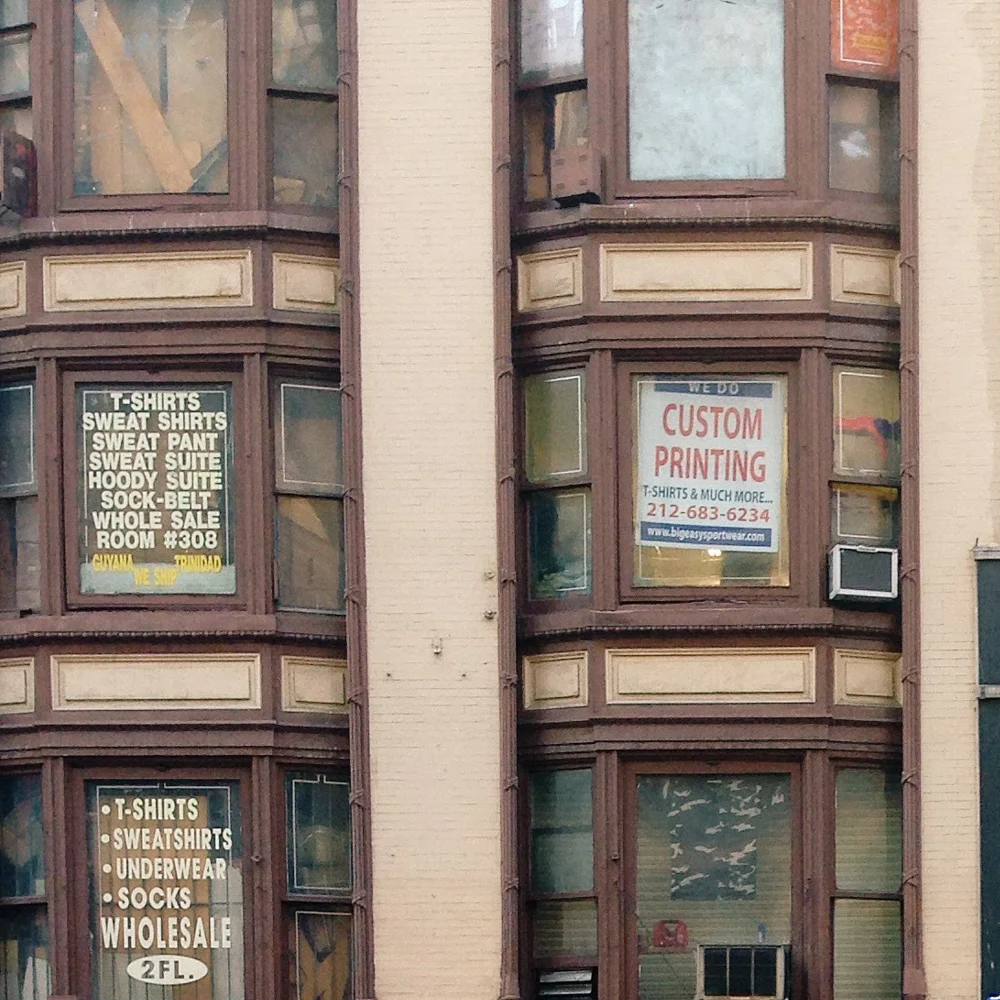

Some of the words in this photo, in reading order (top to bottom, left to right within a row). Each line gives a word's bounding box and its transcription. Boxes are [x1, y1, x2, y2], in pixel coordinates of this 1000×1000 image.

[689, 383, 710, 393] WE
[717, 383, 739, 395] DO
[110, 392, 201, 411] T-SHIRTS
[83, 412, 150, 431] SWEAT
[158, 411, 228, 431] SHIRTS
[662, 403, 763, 440] CUSTOM
[92, 432, 160, 451] SWEAT
[168, 432, 218, 451] PANT
[89, 452, 157, 470] SWEAT
[165, 452, 222, 470] SUITE
[654, 445, 766, 483] PRINTING
[88, 471, 158, 489] HOODY
[166, 471, 223, 490] SUITE
[101, 491, 211, 510] SOCK-BELT
[643, 485, 688, 500] T-SHIRTS
[690, 488, 698, 500] &
[701, 489, 732, 502] MUCH
[92, 511, 162, 530] WHOLE
[170, 511, 221, 529] SALE
[647, 503, 771, 523] 212-683-6234
[96, 531, 155, 549] ROOM
[164, 531, 218, 549] #308
[92, 554, 134, 572] GUYANA
[174, 554, 222, 573] TRINIDAD
[115, 798, 199, 820] T-SHIRTS
[113, 828, 233, 851] SWEATSHIRTS
[115, 857, 227, 880] UNDERWEAR
[117, 887, 191, 910] SOCKS
[100, 916, 233, 950] WHOLESALE
